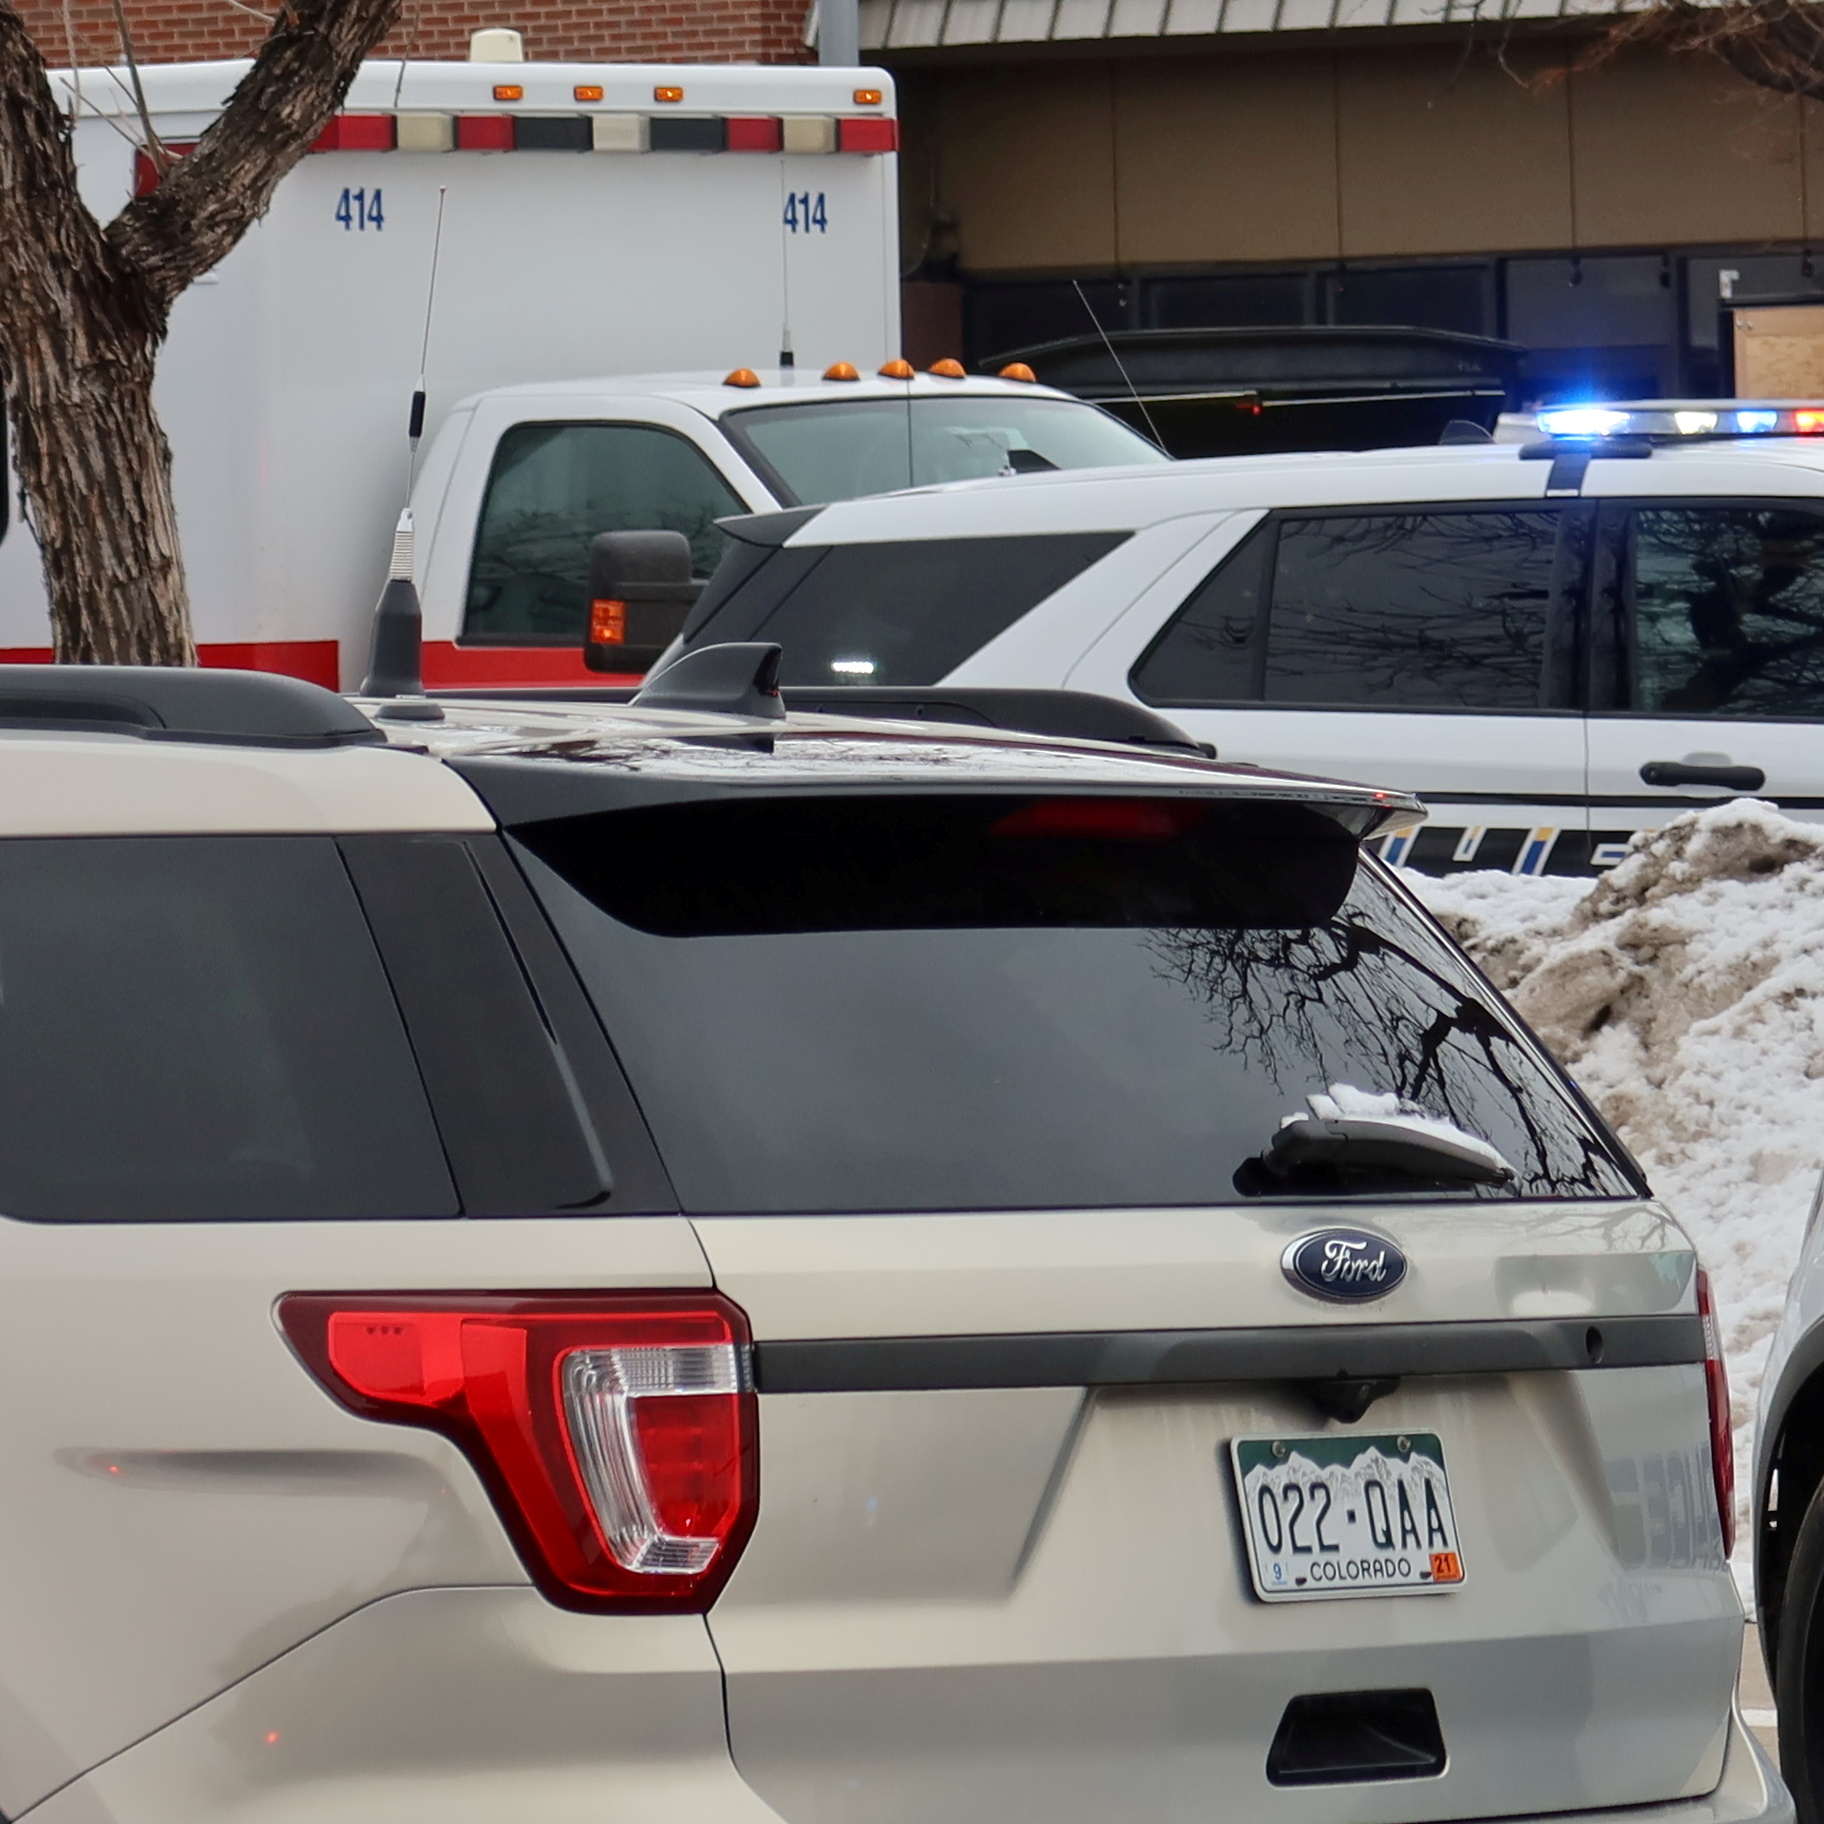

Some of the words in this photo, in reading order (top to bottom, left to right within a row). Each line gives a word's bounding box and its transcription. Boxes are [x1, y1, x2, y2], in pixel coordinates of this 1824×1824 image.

[334, 186, 386, 232] 414
[782, 191, 829, 234] 414
[1320, 1238, 1387, 1283] Ford
[1310, 1557, 1413, 1583] COLORADO
[1433, 1554, 1453, 1574] 21
